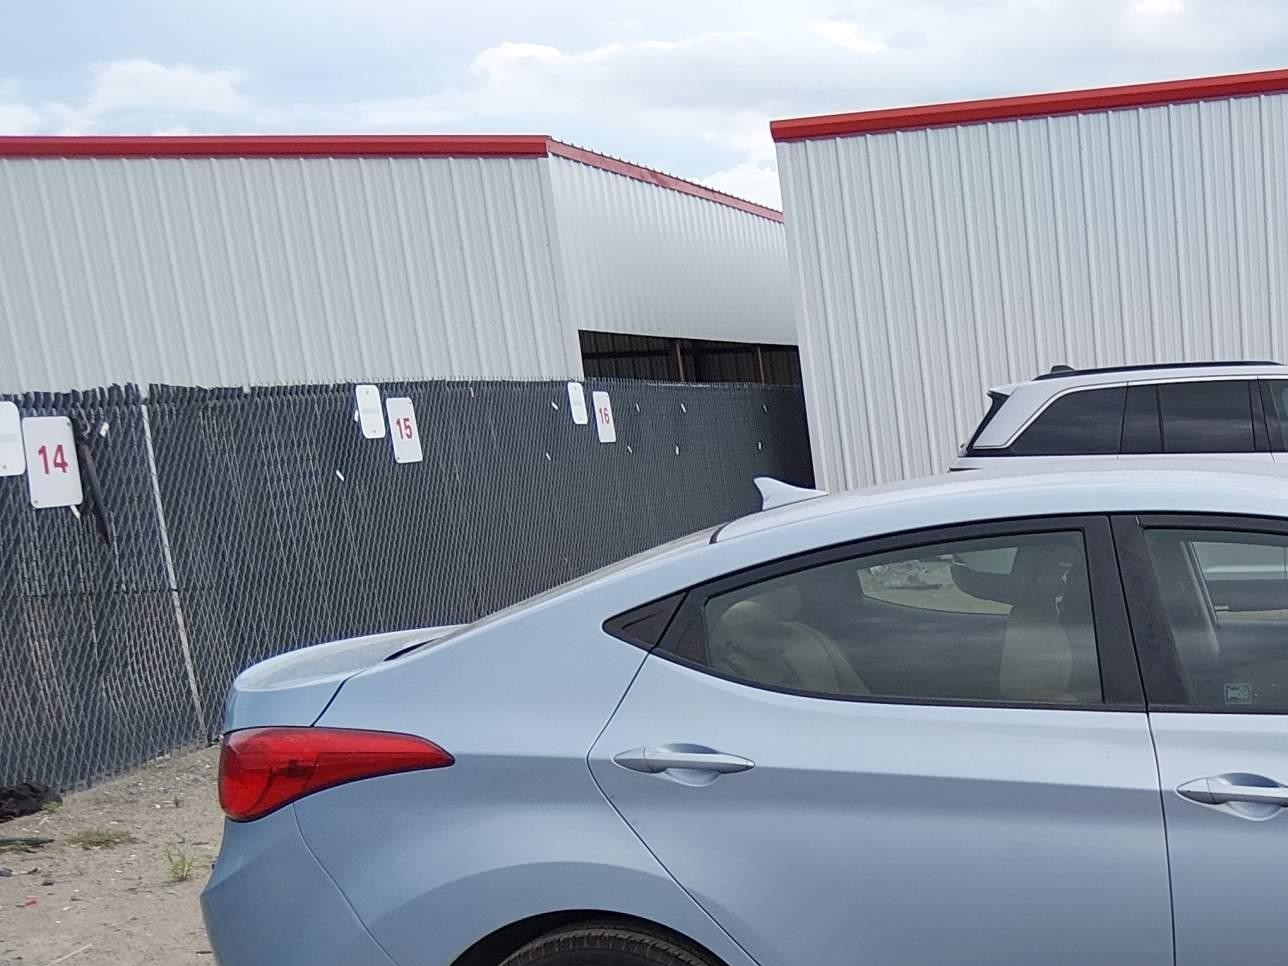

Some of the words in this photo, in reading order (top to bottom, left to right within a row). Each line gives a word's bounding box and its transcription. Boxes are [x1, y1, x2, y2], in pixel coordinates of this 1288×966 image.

[599, 407, 610, 425] 16
[396, 417, 413, 440] 15
[38, 444, 68, 475] 14
